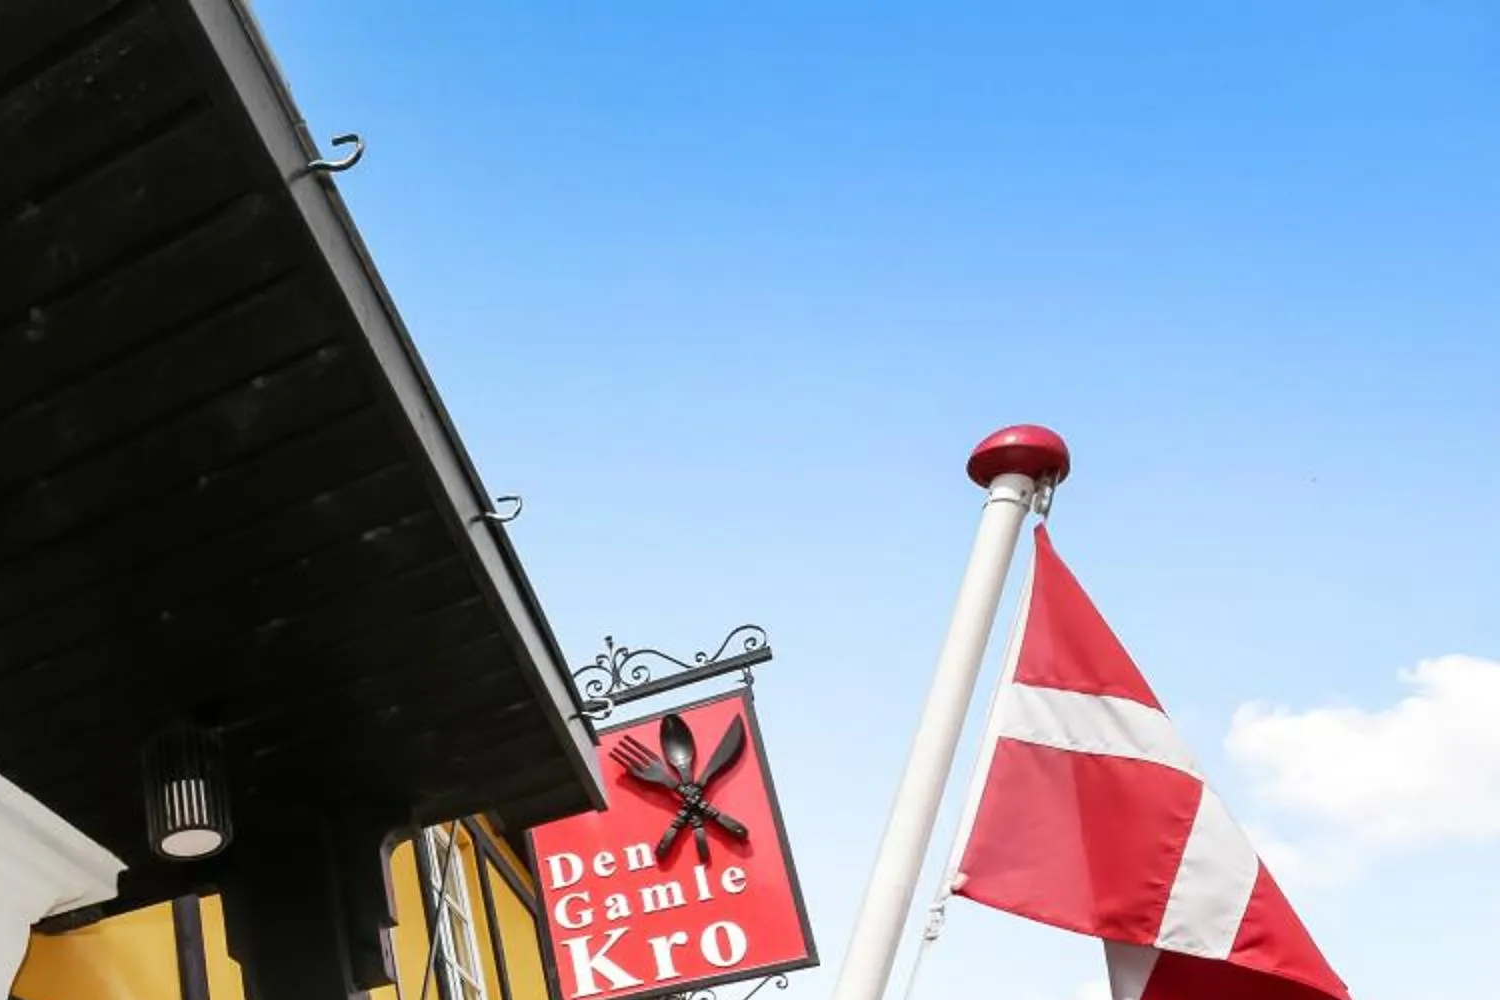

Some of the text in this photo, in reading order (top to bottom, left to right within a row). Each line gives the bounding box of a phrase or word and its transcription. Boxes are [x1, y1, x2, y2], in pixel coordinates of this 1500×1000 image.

[545, 841, 656, 890] Den
[554, 864, 748, 930] Gamle
[561, 920, 748, 999] Kro
